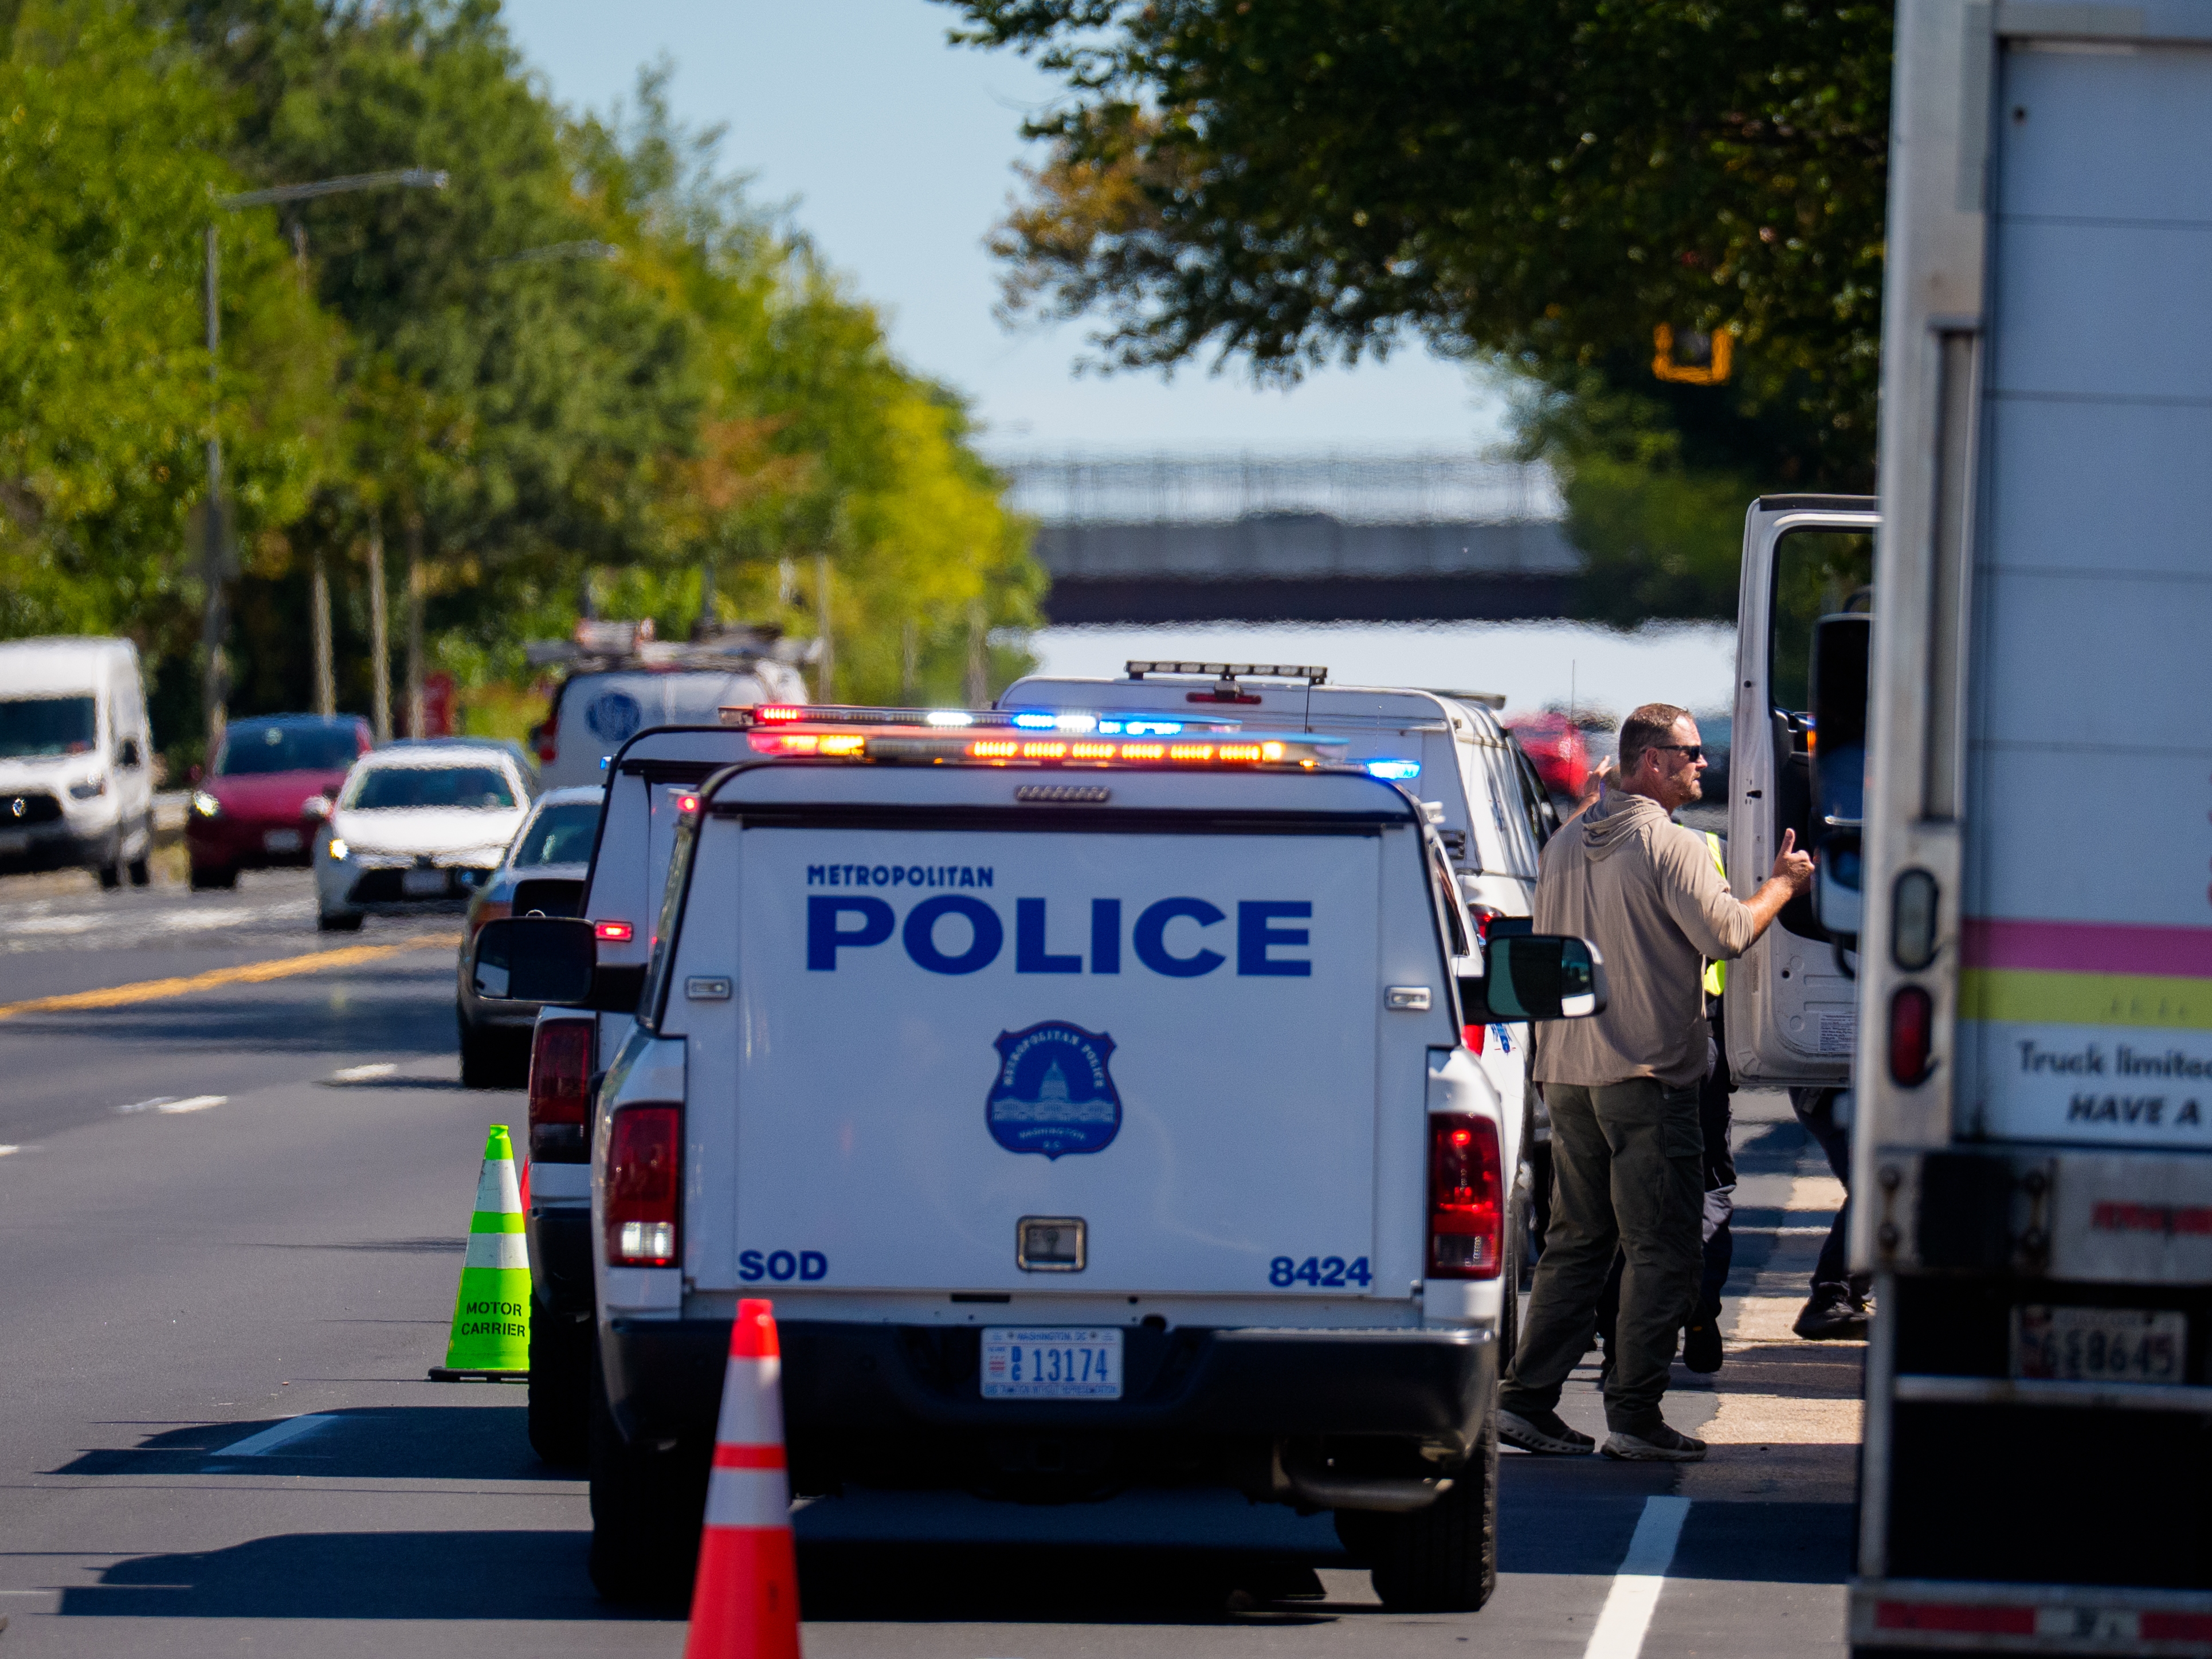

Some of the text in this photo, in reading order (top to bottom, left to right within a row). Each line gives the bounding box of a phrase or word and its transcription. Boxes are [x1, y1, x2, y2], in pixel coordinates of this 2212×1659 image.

[806, 864, 994, 887] METROPOLITAN
[806, 894, 1313, 978] POLICE
[2018, 1040, 2104, 1076] Truck
[2066, 1093, 2201, 1127] HAVE A
[739, 1249, 827, 1281] SOD
[1269, 1256, 1372, 1287] 8424
[466, 1301, 522, 1317] MOTOR
[461, 1322, 525, 1338] CARRIER
[1033, 1348, 1108, 1382] 13174
